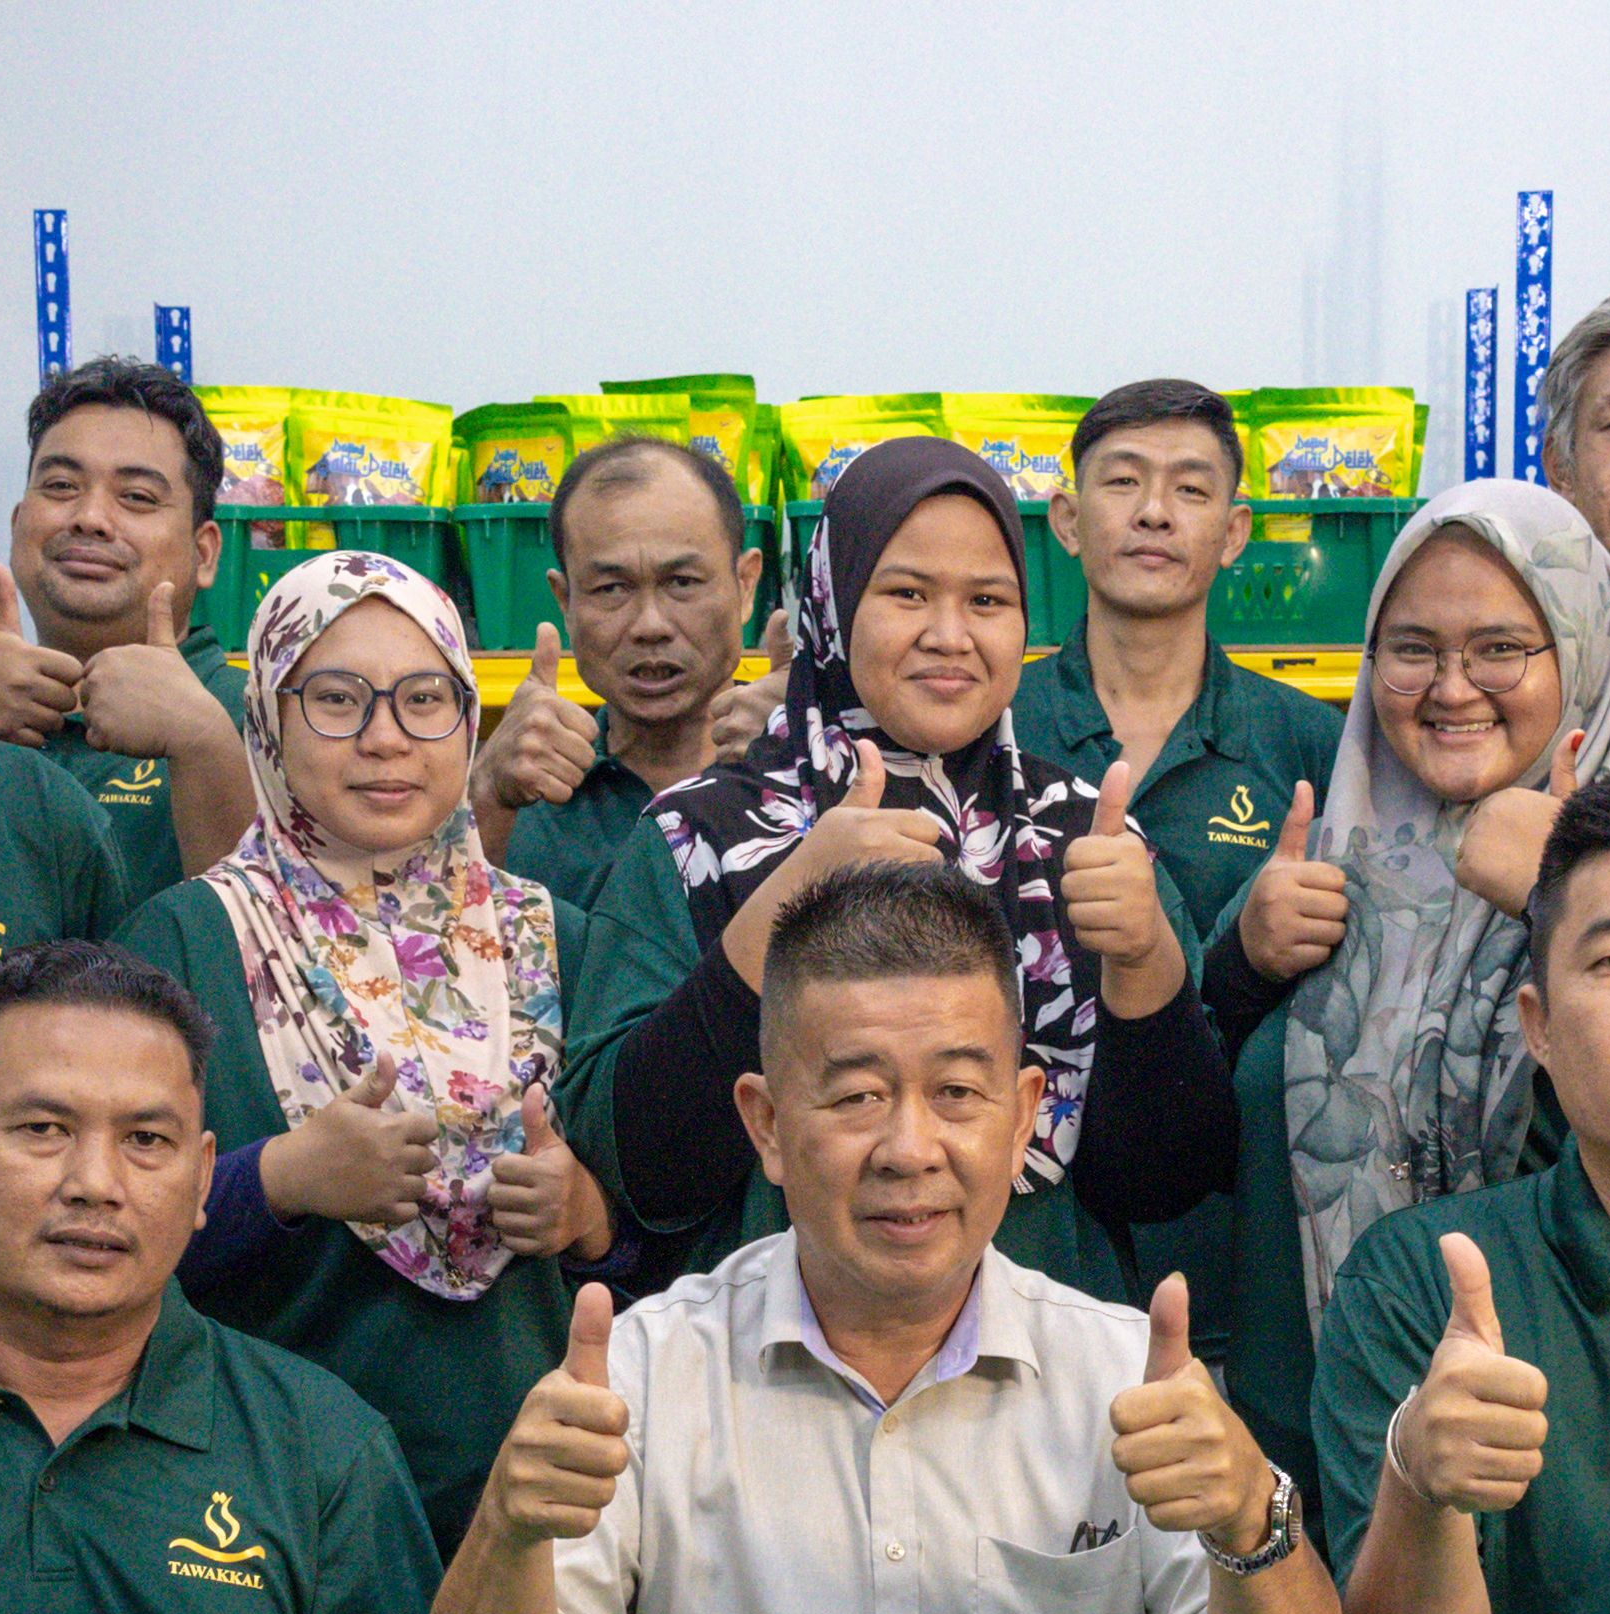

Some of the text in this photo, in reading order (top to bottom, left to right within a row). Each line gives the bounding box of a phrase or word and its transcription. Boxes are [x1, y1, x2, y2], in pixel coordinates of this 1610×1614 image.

[98, 792, 153, 805] TAWAKKAL
[1207, 831, 1269, 849] TAWAKKAL
[168, 1560, 264, 1589] TAWAKKAL
